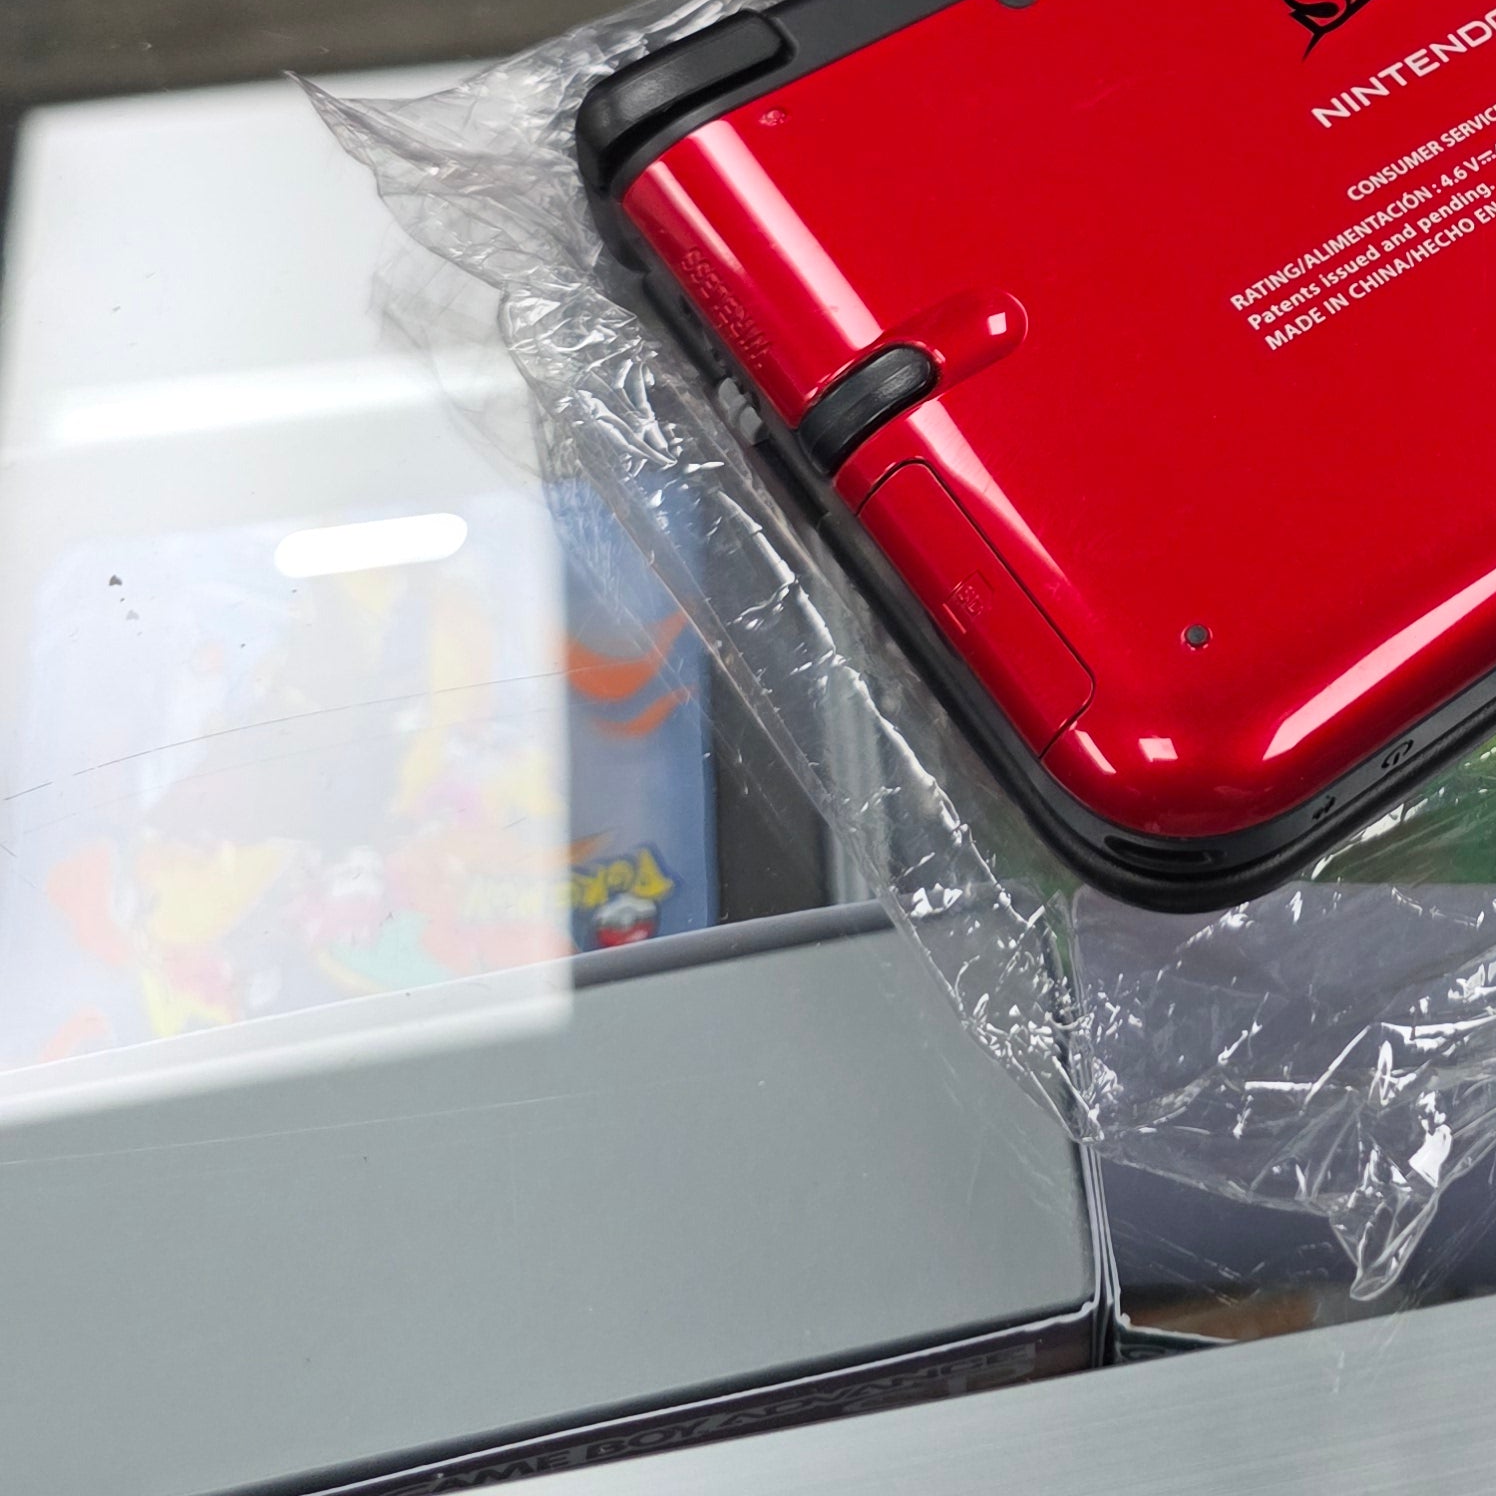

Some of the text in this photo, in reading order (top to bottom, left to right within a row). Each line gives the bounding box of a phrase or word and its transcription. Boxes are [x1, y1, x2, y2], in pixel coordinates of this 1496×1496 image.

[1347, 140, 1444, 201] CONSUMER
[1440, 166, 1468, 187] 4.6
[1247, 183, 1495, 330] Patents issued and pending.
[1264, 307, 1326, 351] MADE
[1323, 293, 1350, 315] IN
[1348, 218, 1475, 299] CHINA/HECHO
[586, 1416, 705, 1468] BOY
[716, 1351, 1026, 1430] ADVANCE
